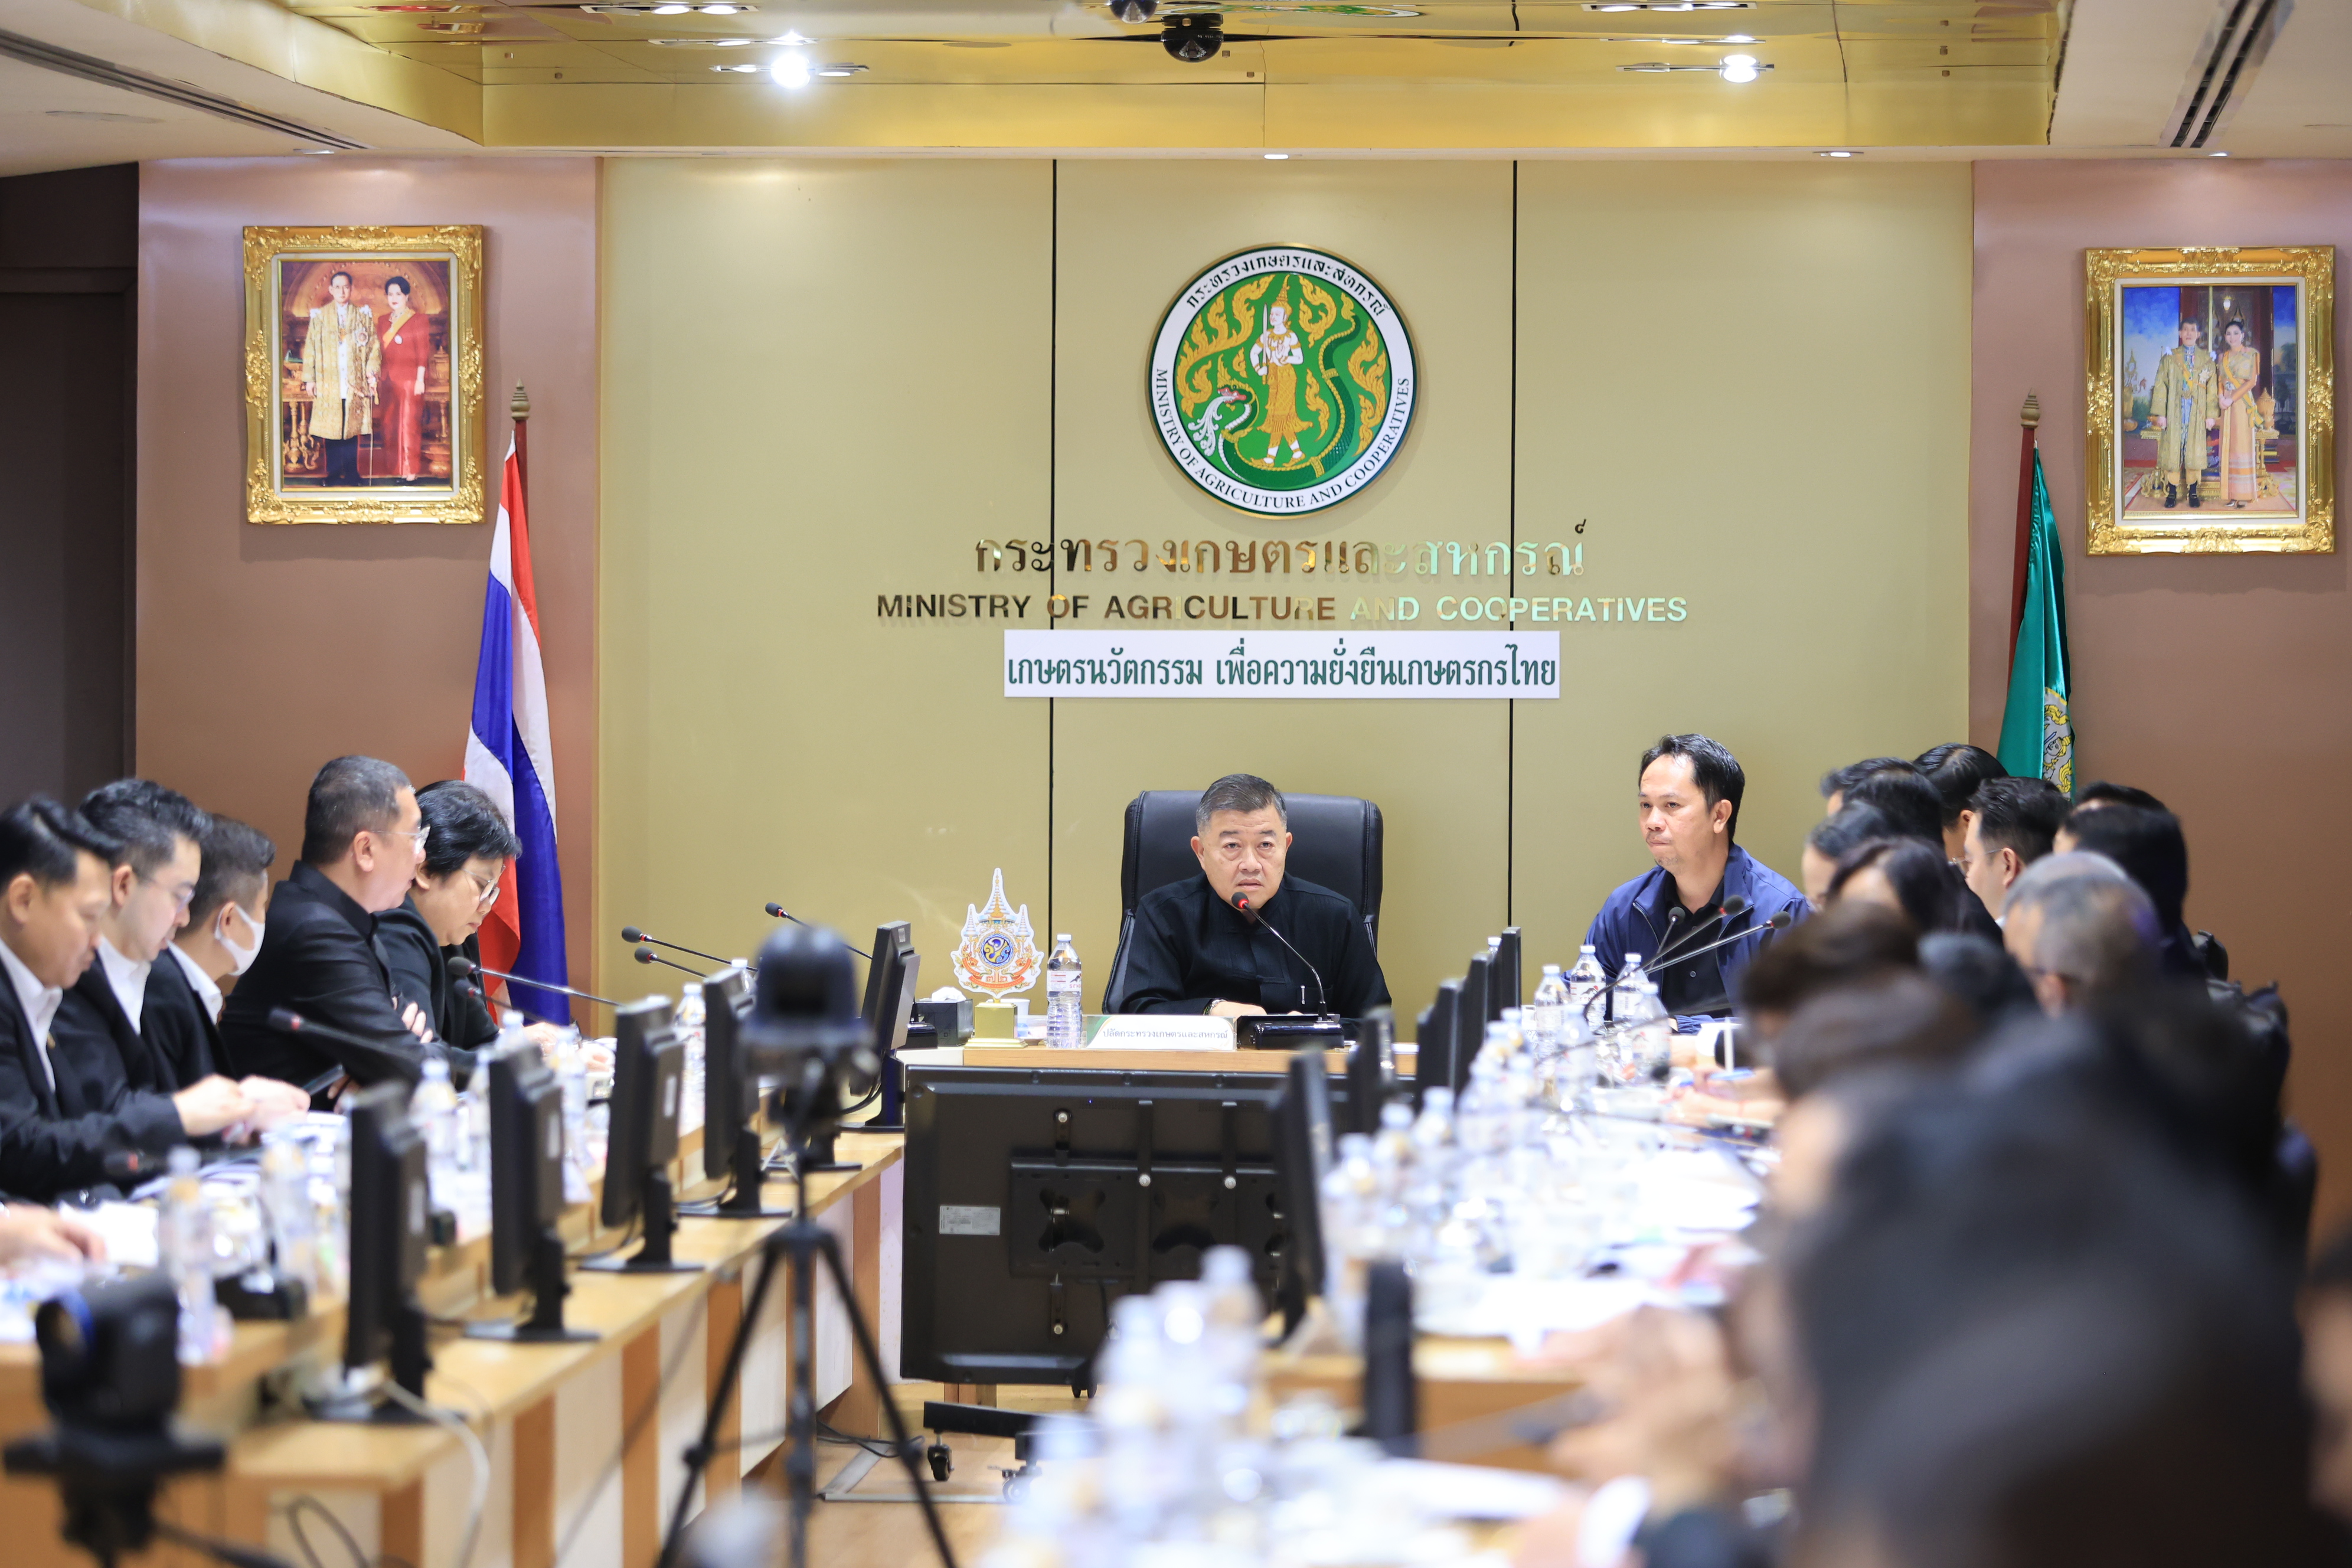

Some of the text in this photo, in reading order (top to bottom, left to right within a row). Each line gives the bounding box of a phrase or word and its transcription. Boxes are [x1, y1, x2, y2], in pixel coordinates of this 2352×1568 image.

[1155, 368, 1409, 508] MINISTRY OF AGRICULTURE AND COOPERATIVES
[975, 519, 1586, 576] กระทรวงเกษตรและสหกรณ์
[877, 593, 1687, 622] MINISTRY OF AGRICULTURE AND COOPERATIVES
[1008, 638, 1556, 685] เกษตรนวัตกรรม เพื่อความยั่งยืนเกษตรกรไทย
[1103, 1028, 1229, 1039] ปลัดกระทรวงเกษตรและสหกรณ์
